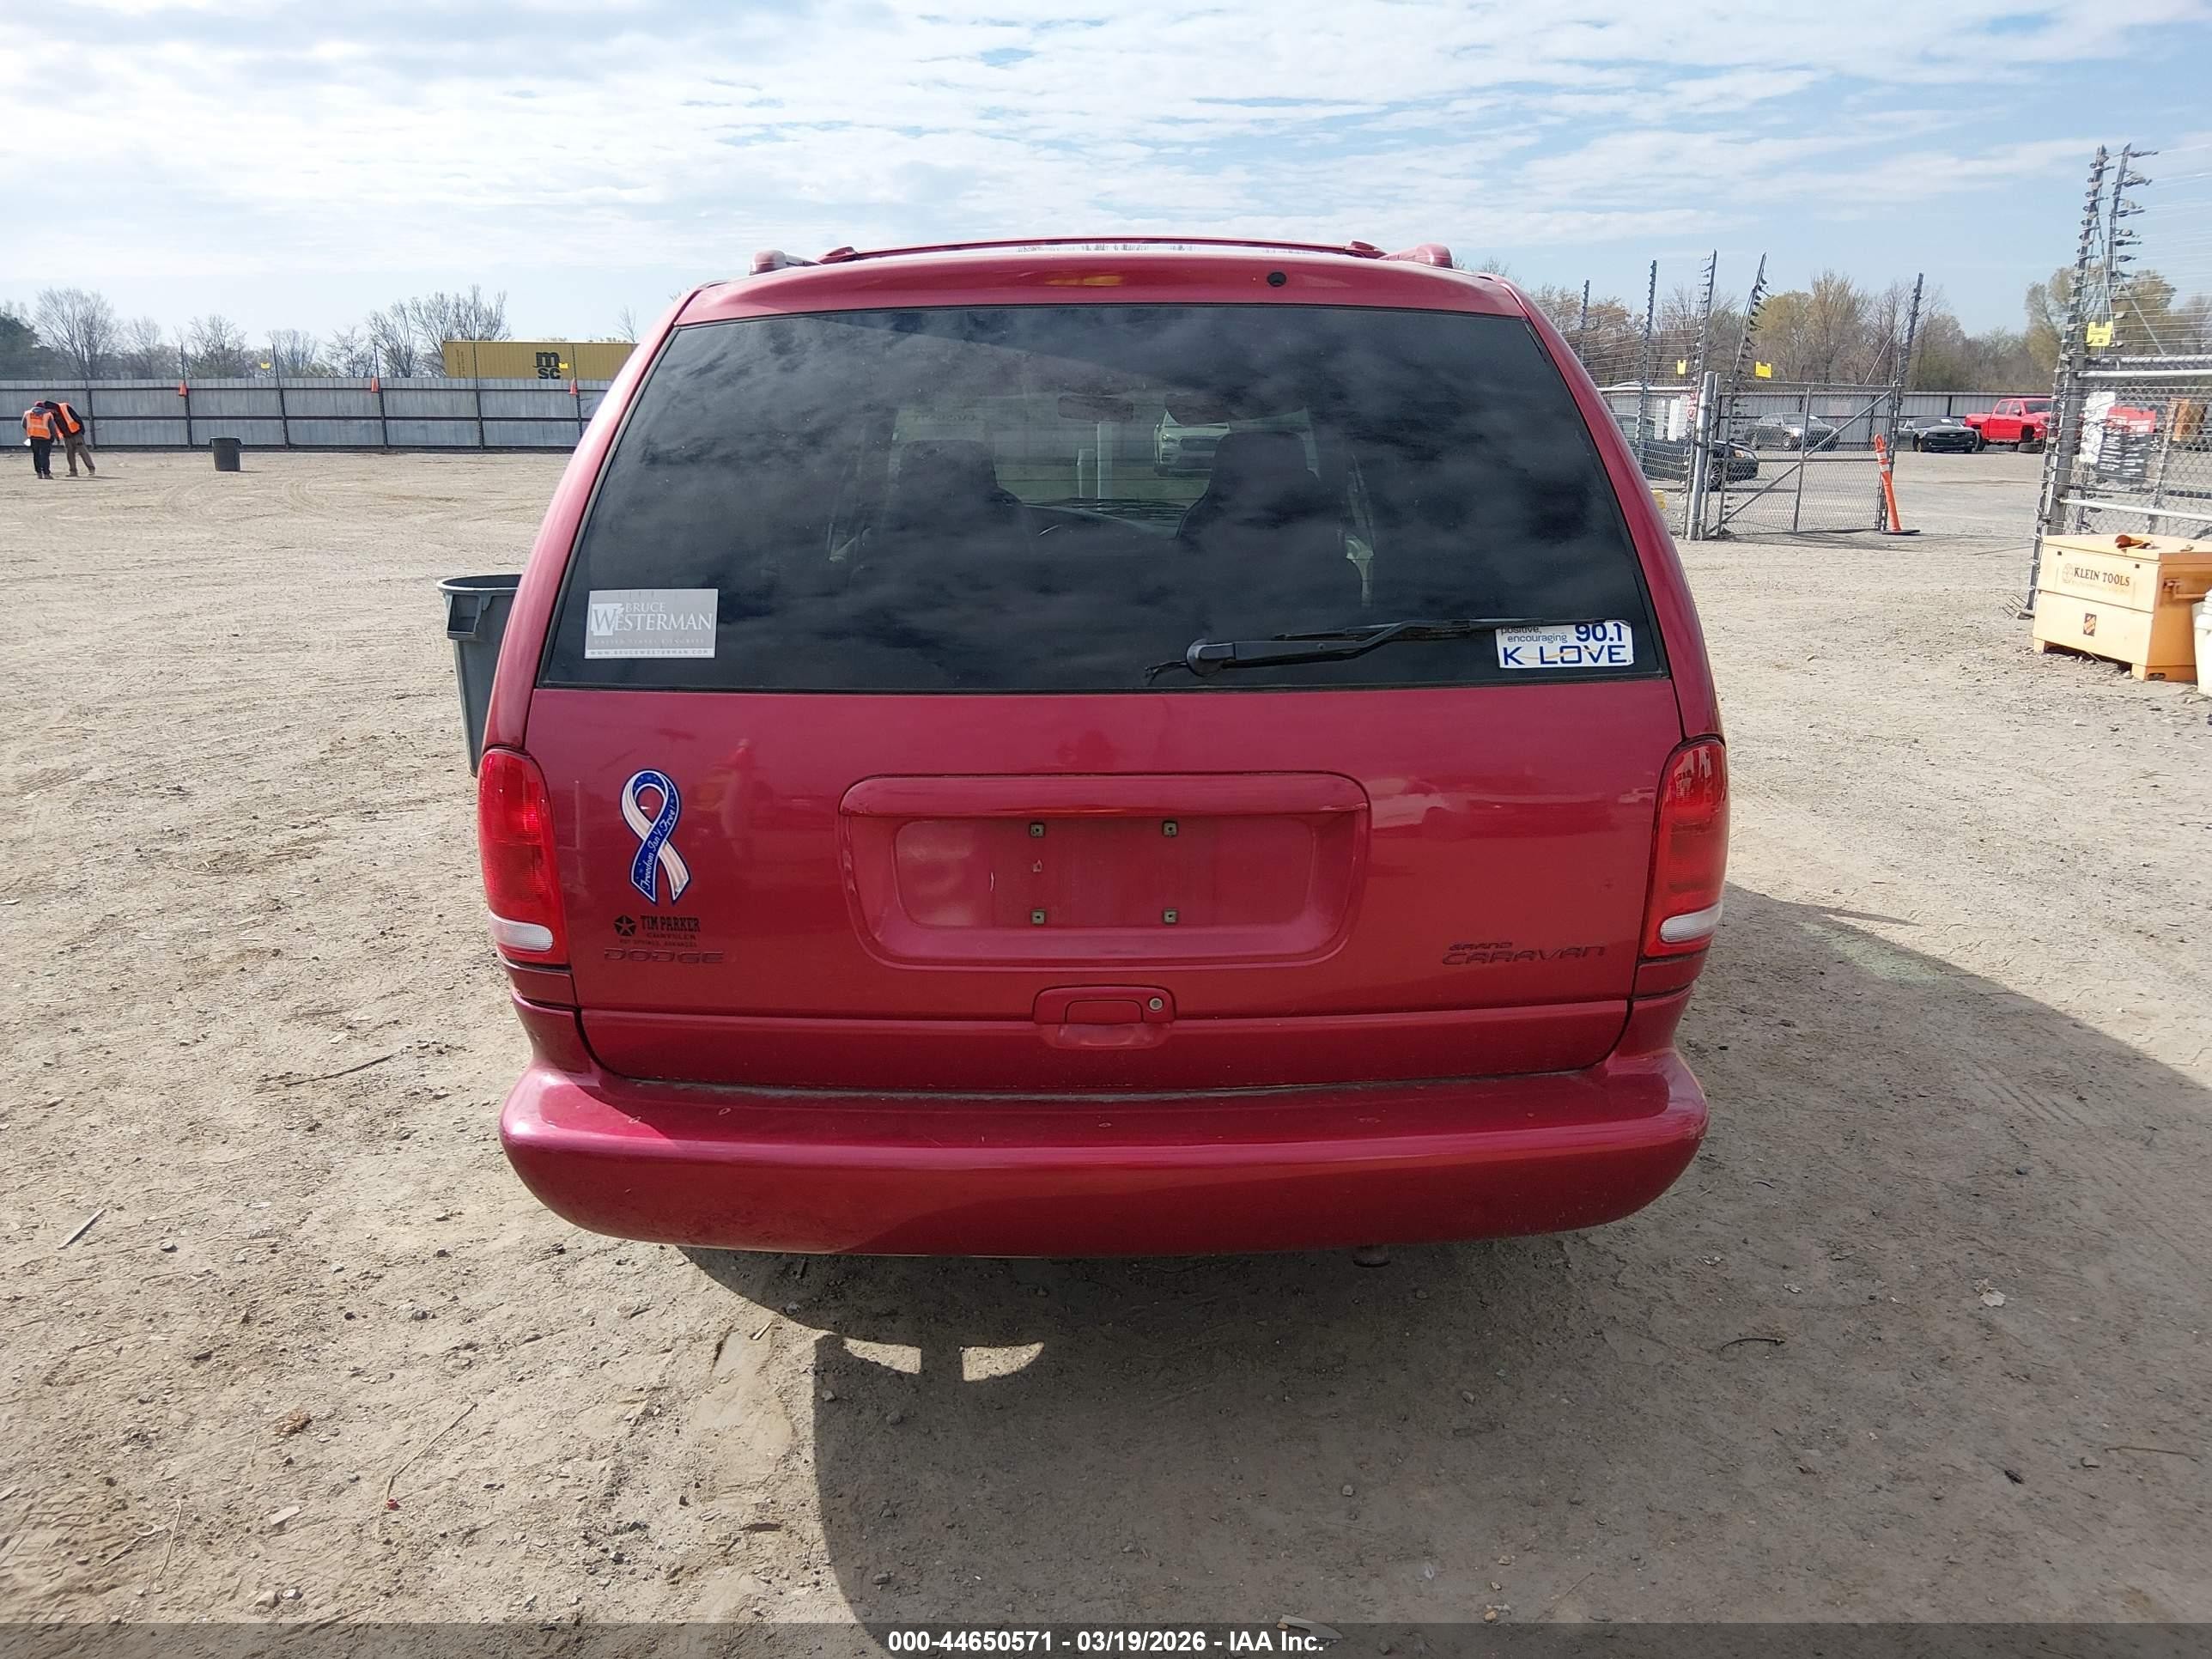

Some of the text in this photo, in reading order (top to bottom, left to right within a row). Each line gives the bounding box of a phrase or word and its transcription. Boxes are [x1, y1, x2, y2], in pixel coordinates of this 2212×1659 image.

[2074, 567, 2100, 580] KLEIN
[2102, 572, 2130, 586] TOOLS
[625, 602, 666, 613] BRUCE
[592, 608, 713, 632] WESTERMAN
[1507, 633, 1568, 643] encouraging
[1575, 623, 1623, 642] 90.1
[1503, 645, 1627, 665] K LOVE
[640, 853, 655, 890] Freedom
[640, 915, 701, 933] TIM PARKER
[604, 947, 724, 963] DODGE
[1442, 946, 1606, 965] CARAVAN
[1449, 942, 1514, 951] GRAND
